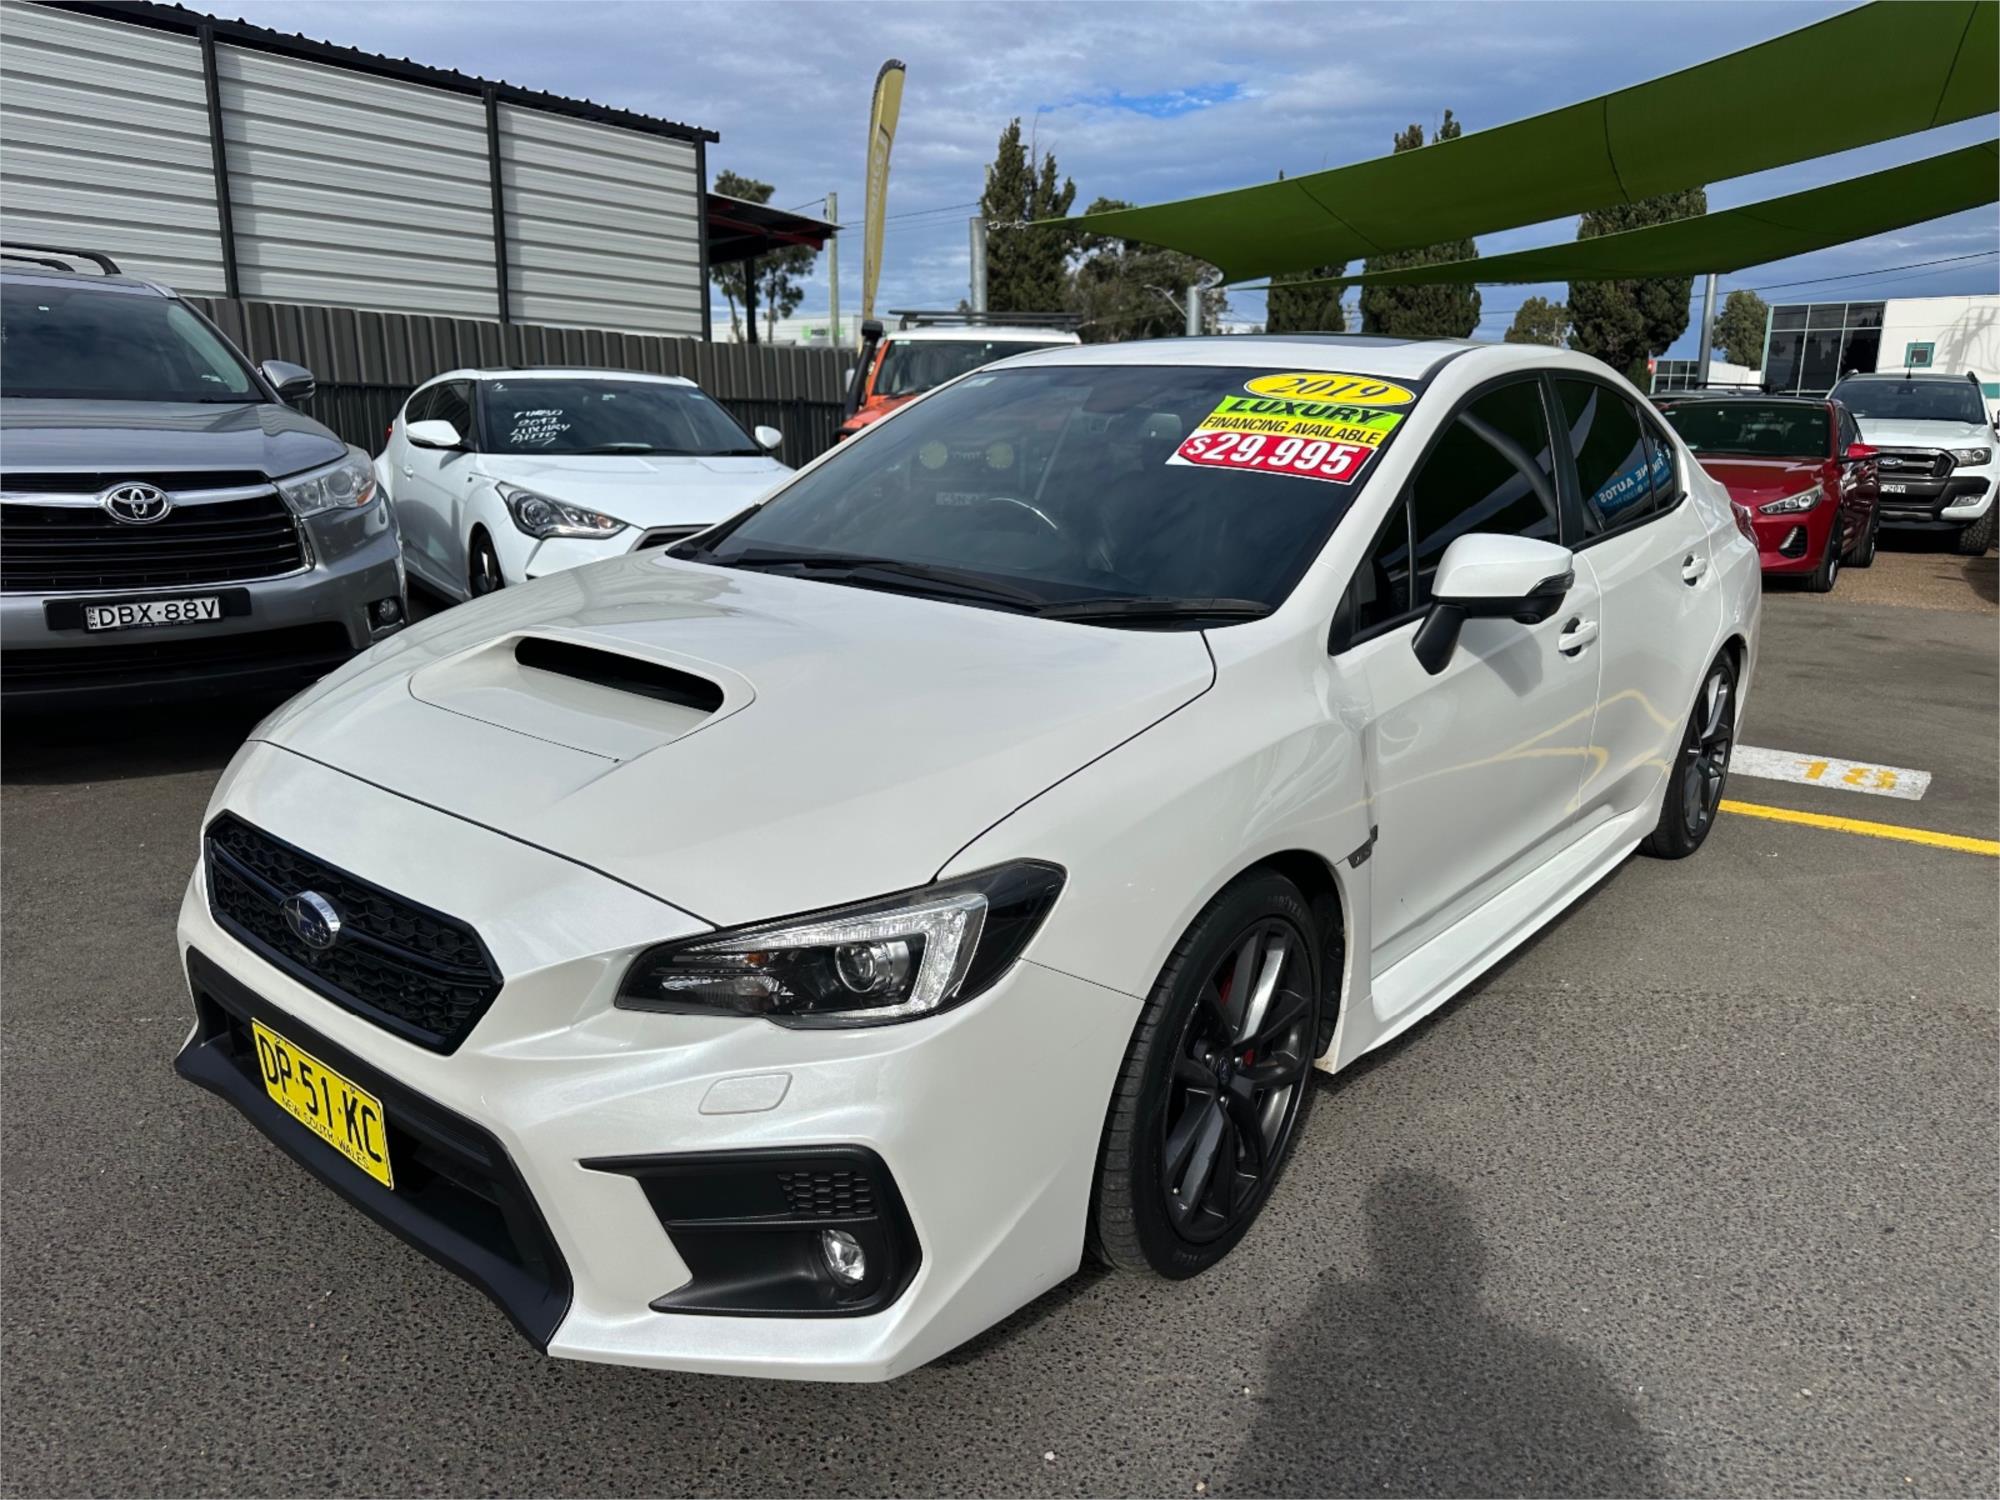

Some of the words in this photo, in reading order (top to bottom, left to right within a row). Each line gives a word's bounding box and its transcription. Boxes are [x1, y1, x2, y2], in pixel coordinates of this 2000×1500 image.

[1269, 376, 1391, 399] 2019
[1225, 399, 1386, 424] LUXURY
[1203, 416, 1291, 432] FINANCING
[1288, 421, 1383, 444] AVAILABLE
[1185, 434, 1360, 475] $29,995
[281, 1095, 301, 1116] NEW
[303, 1114, 335, 1143] SOUTH
[337, 1137, 370, 1170] WALES
